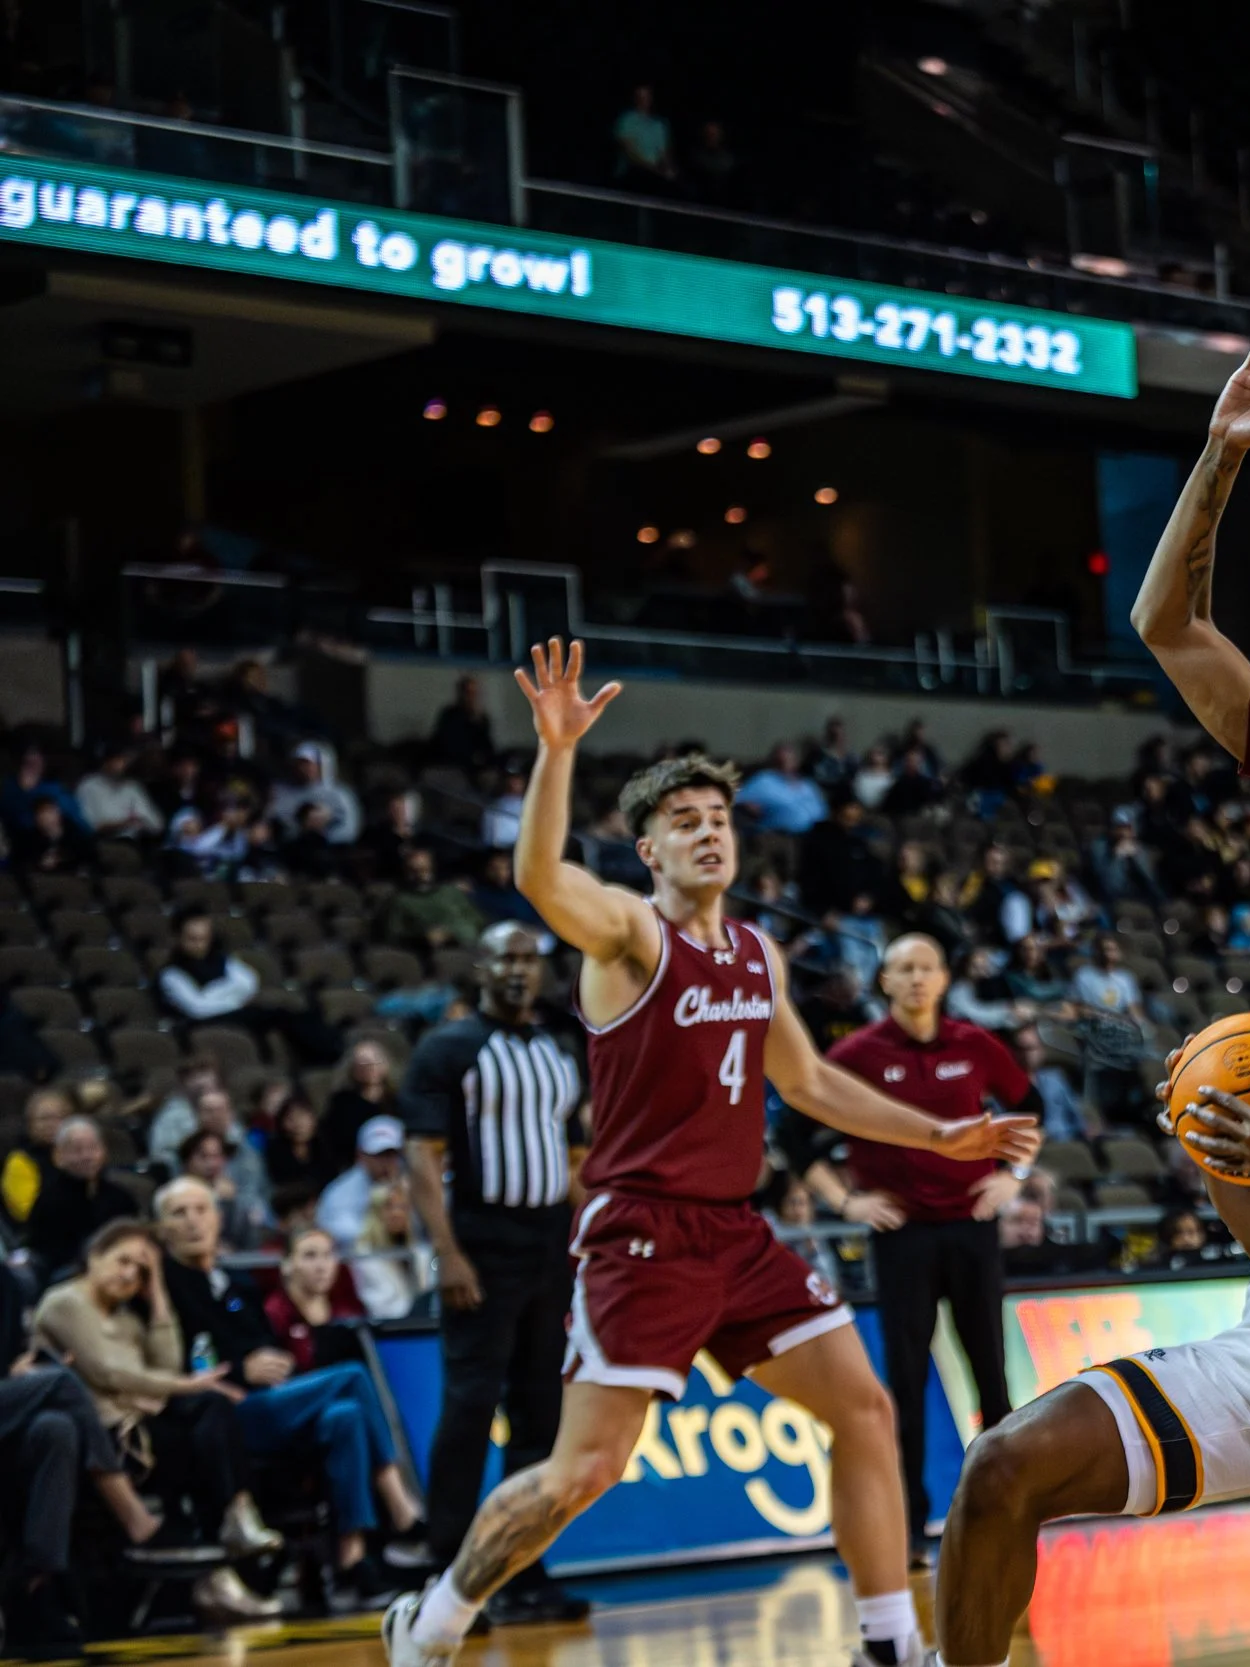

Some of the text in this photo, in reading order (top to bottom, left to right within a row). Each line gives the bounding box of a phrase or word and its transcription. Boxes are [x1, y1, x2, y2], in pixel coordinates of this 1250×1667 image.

[0, 175, 338, 261] guaranteed
[353, 221, 418, 270] to
[772, 287, 1081, 375] 513-271-2332
[674, 985, 771, 1028] Charleston
[718, 1029, 747, 1105] 4
